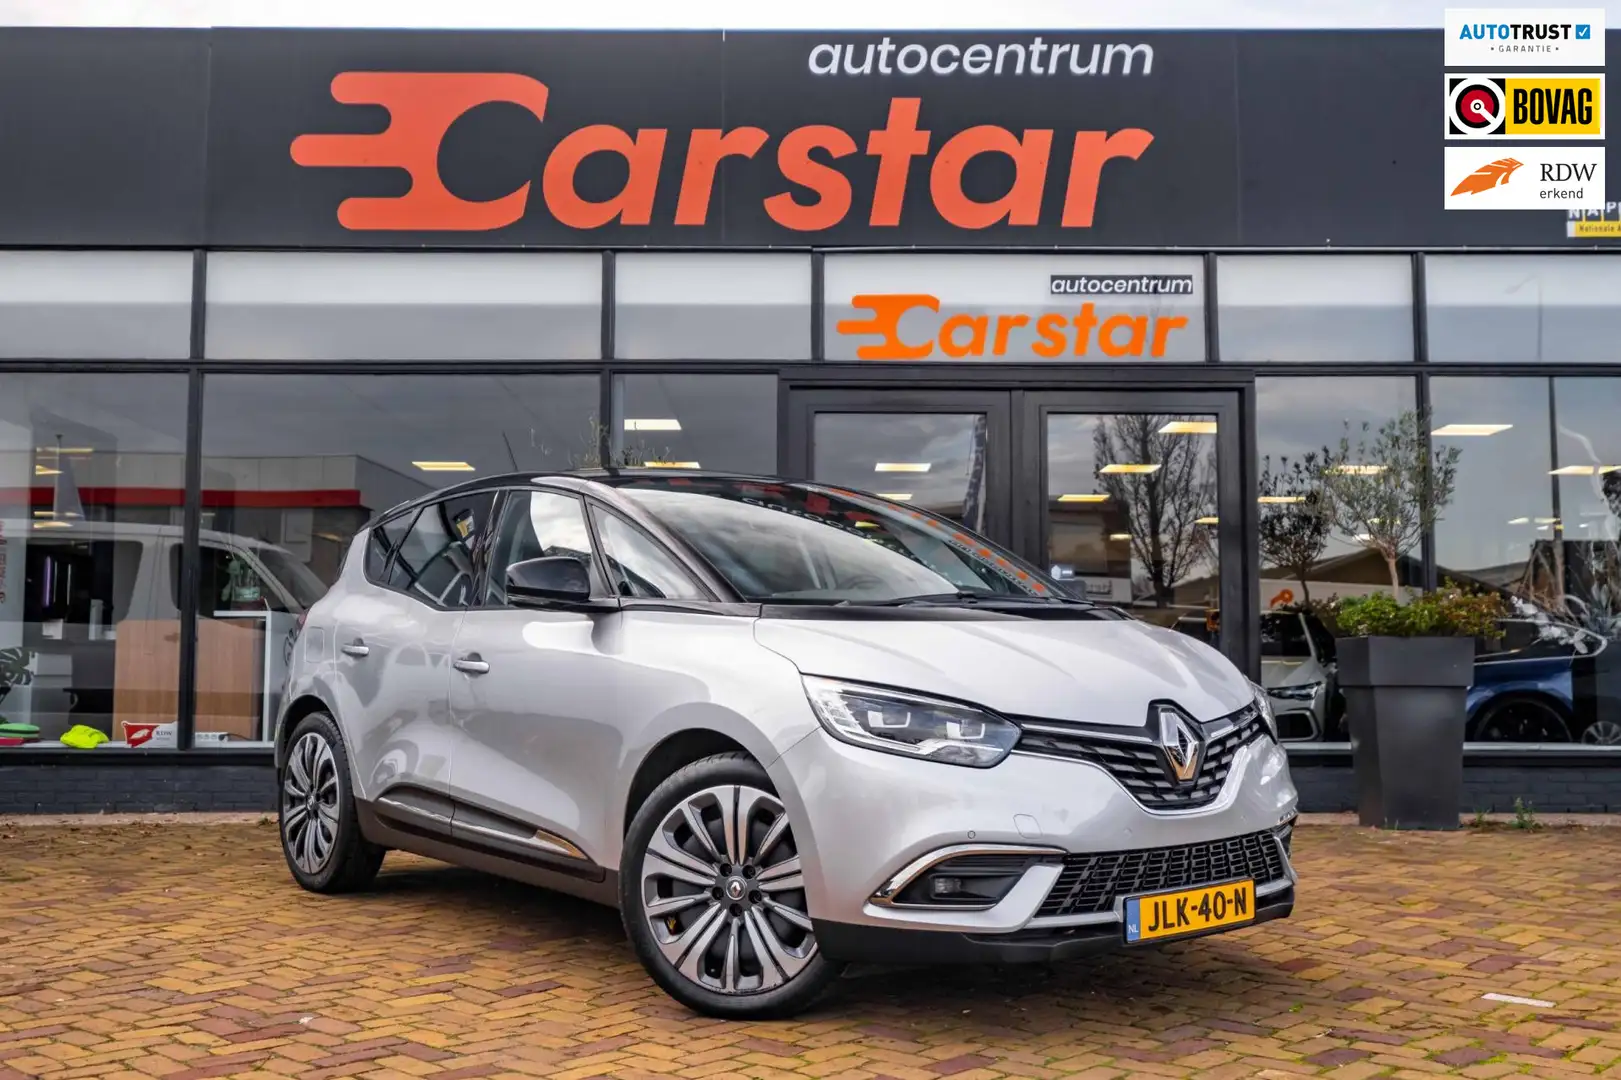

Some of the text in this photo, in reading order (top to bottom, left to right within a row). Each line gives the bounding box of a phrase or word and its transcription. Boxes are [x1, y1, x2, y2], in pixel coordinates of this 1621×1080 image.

[808, 37, 1154, 78] autocentrum
[290, 71, 1154, 231] Carstar
[1051, 277, 1192, 293] autocentrum
[836, 294, 1189, 361] Carstar
[1128, 887, 1247, 934] NL JLK-40-N
